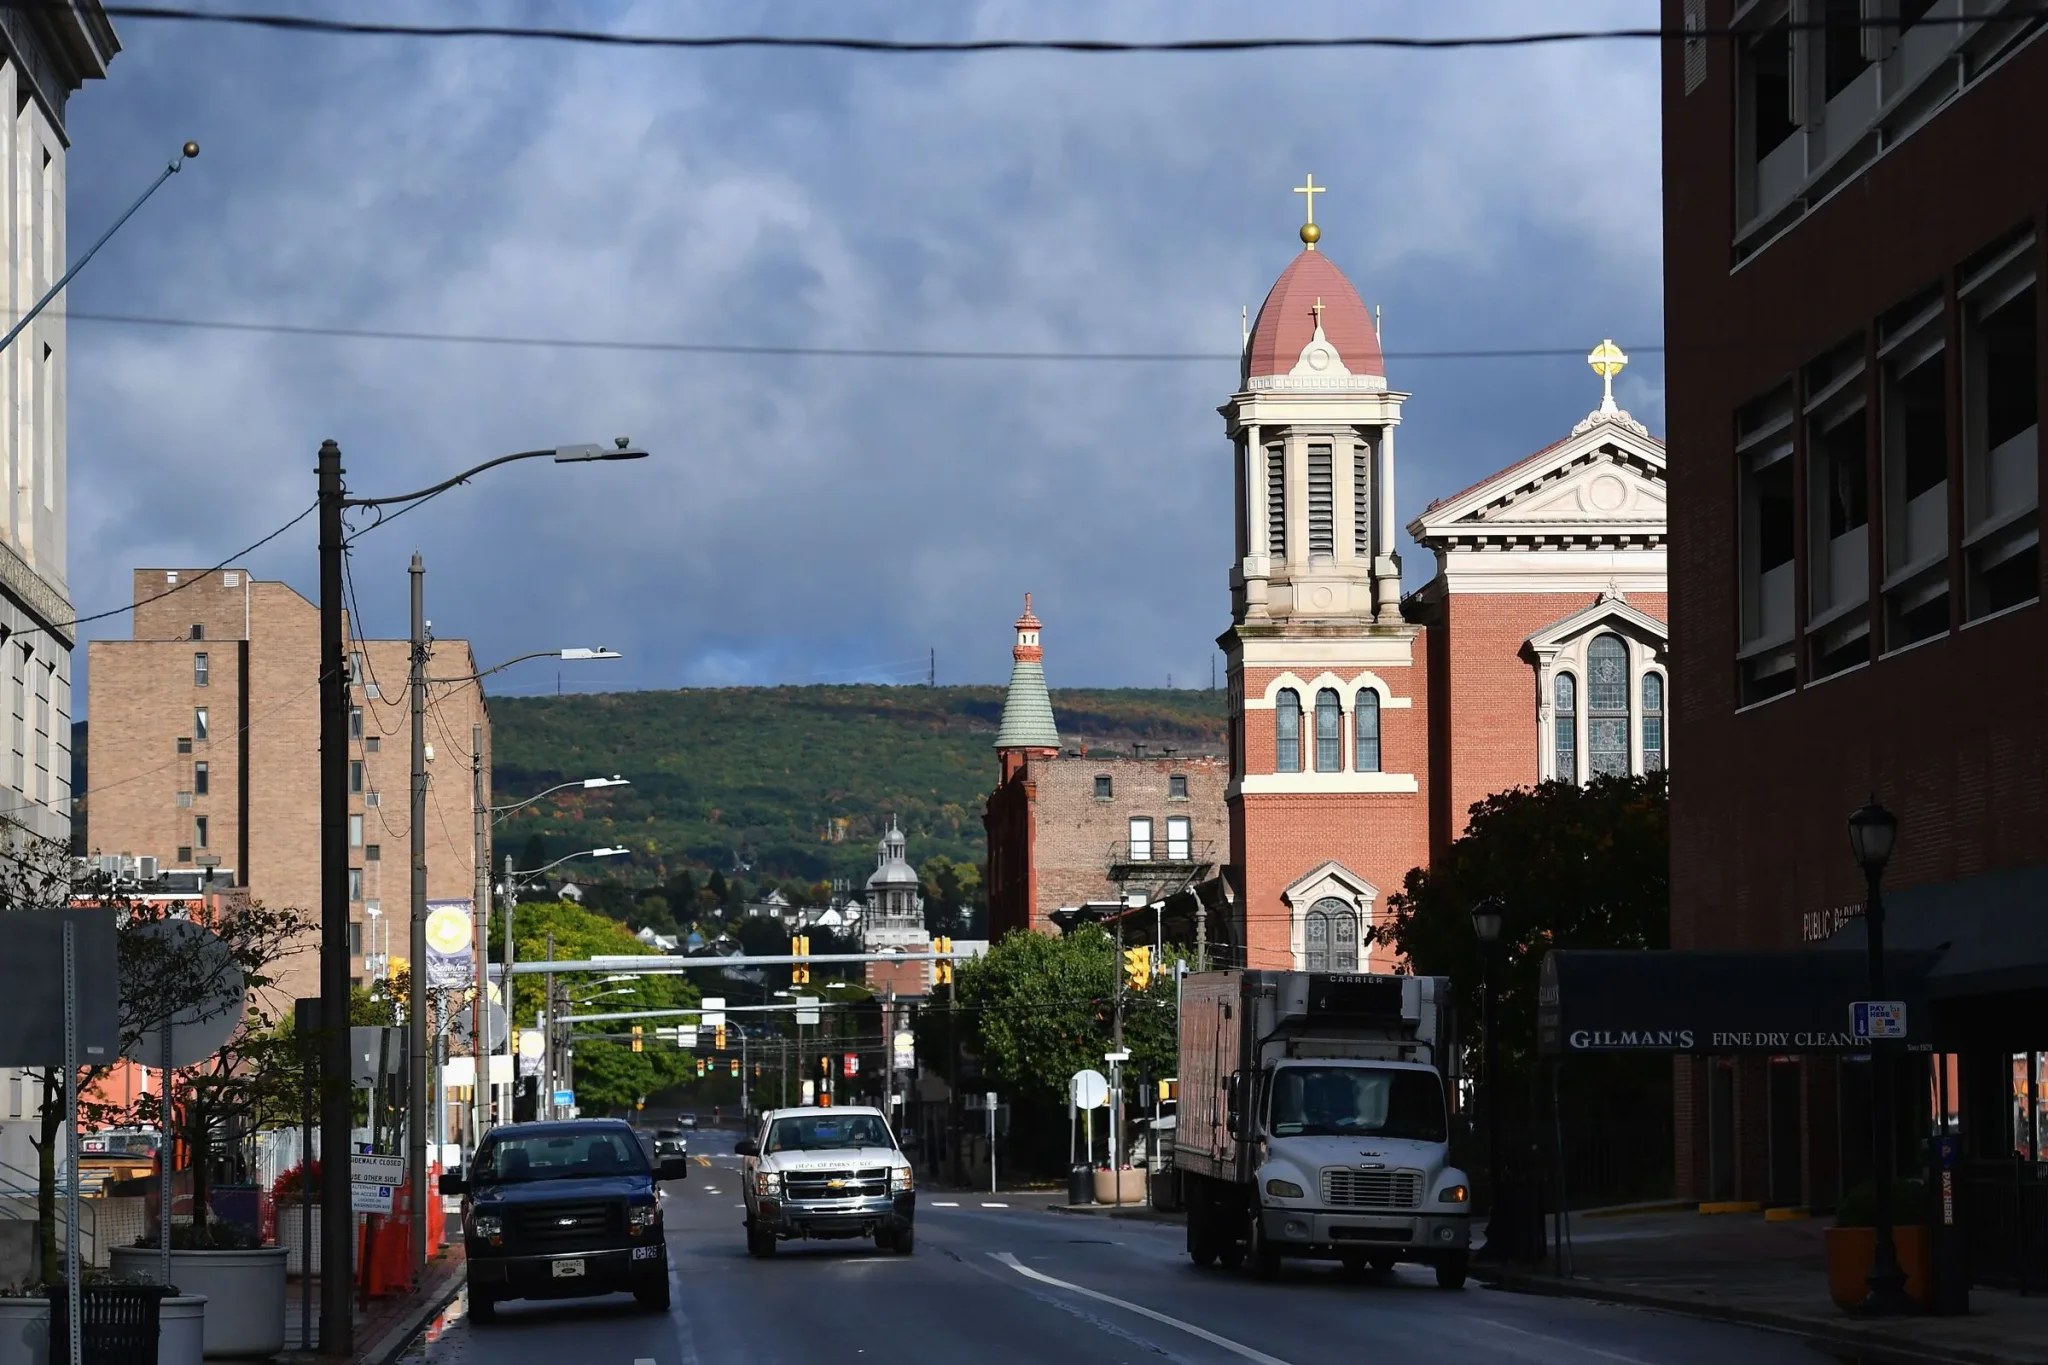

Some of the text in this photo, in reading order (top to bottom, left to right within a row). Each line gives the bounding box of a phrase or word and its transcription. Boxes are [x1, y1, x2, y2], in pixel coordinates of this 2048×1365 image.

[1803, 910, 1831, 942] PUBLIC
[1329, 975, 1383, 984] CARRIER
[1569, 1029, 1695, 1049] GILMAN'S
[1712, 1032, 1752, 1047] FINE
[1755, 1032, 1790, 1047] DRY
[379, 1159, 402, 1167] CLOSED
[364, 1174, 383, 1182] OTHER
[1942, 1171, 1953, 1225] PAY HERE
[636, 1245, 657, 1259] C-126
